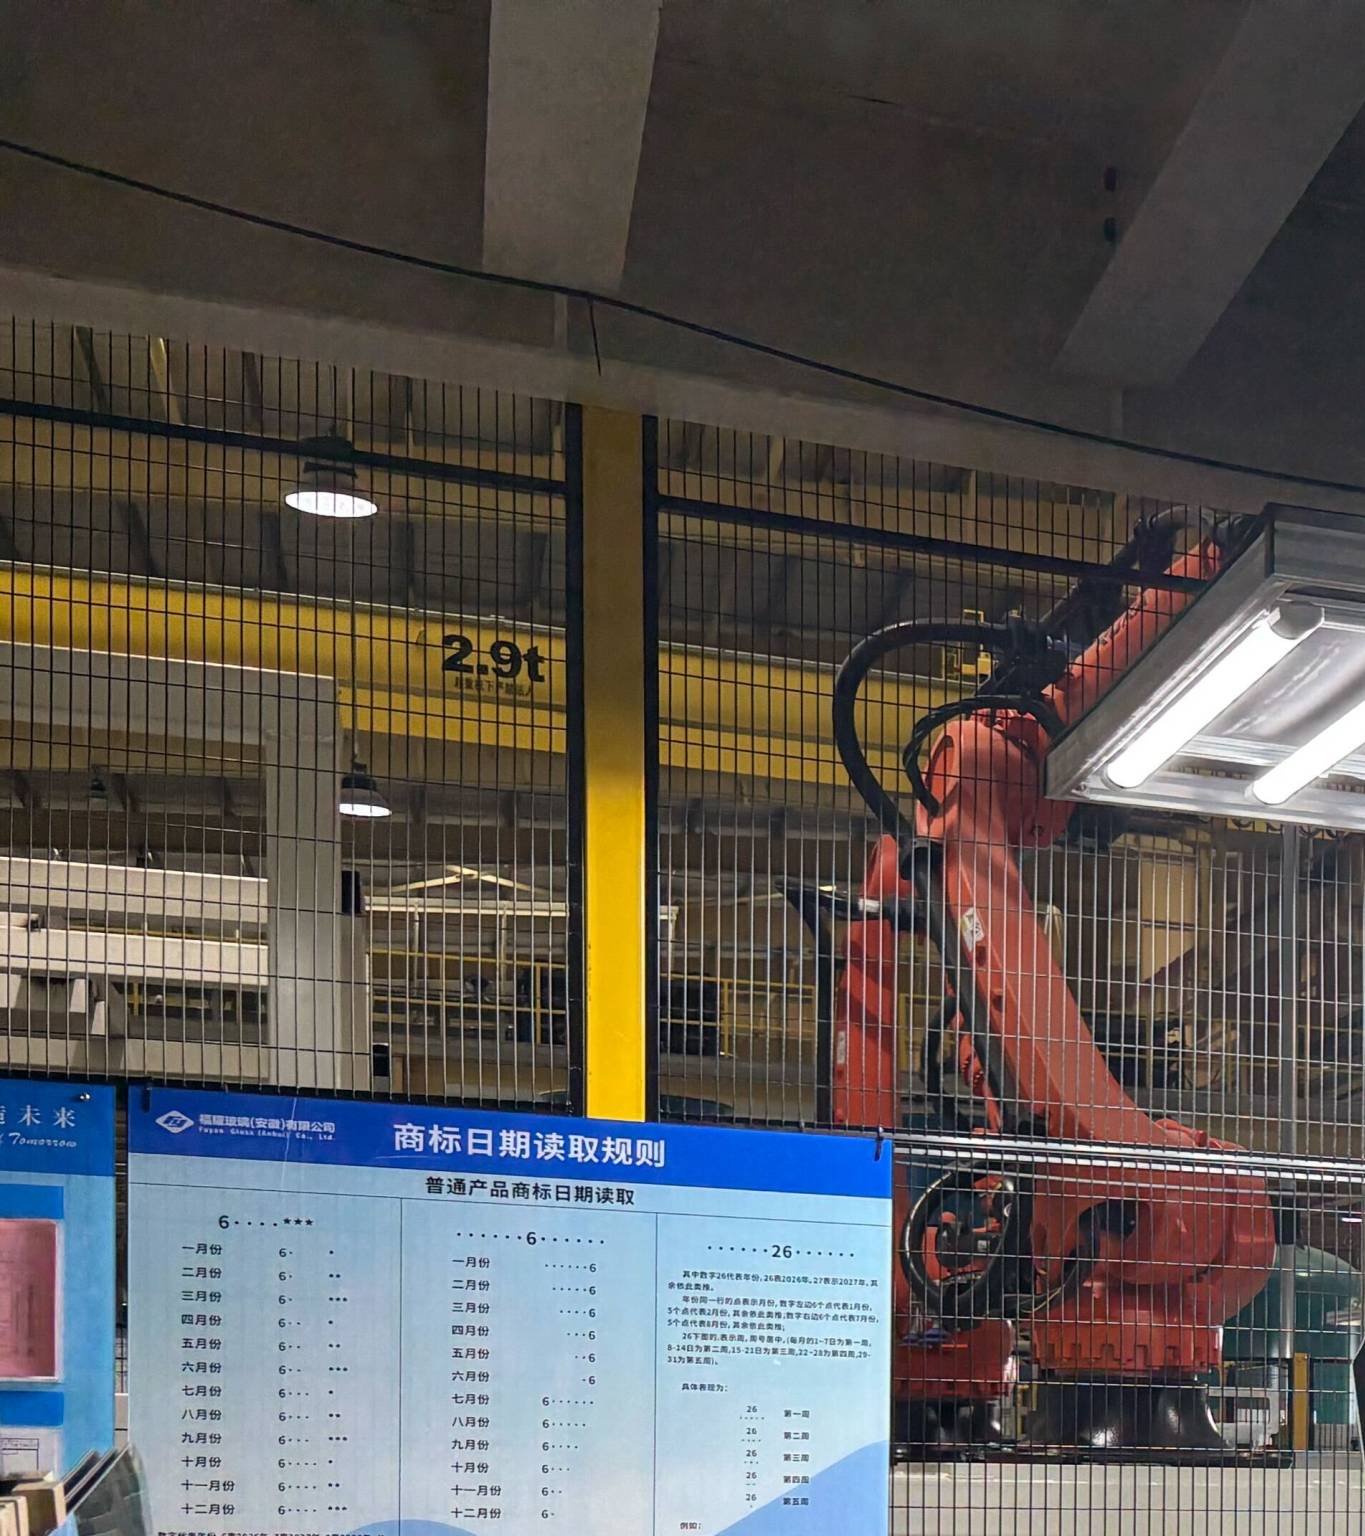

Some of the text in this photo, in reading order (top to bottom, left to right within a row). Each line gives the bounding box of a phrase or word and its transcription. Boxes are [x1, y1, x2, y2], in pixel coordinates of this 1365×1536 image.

[442, 634, 545, 682] 2.9t
[8, 1132, 77, 1147] Tomorrow
[393, 1122, 665, 1168] 商标日期读取规则
[425, 1176, 635, 1205] 普通产品商标日期读取
[181, 1243, 223, 1256] 一月份
[451, 1257, 490, 1268] 一月份
[181, 1266, 223, 1279] 二月份
[451, 1280, 490, 1291] 二月份
[181, 1291, 223, 1303] 三月份
[451, 1302, 490, 1314] 三月份
[181, 1314, 223, 1326] 四月份
[451, 1326, 490, 1337] 四月份
[181, 1338, 223, 1350] 五月份
[451, 1348, 490, 1360] 五月份
[181, 1362, 223, 1374] 六月份
[451, 1371, 490, 1382] 六月份
[181, 1385, 223, 1397] 七月份
[451, 1394, 490, 1405] 七月份
[181, 1409, 223, 1421] 八月份
[451, 1416, 490, 1428] 八月份
[181, 1432, 223, 1444] 九月份
[451, 1439, 490, 1451] 九月份
[181, 1456, 223, 1468] 十月份
[451, 1462, 490, 1474] 十月份
[181, 1480, 236, 1492] 十一月份
[451, 1485, 501, 1496] 十一月份
[181, 1503, 236, 1516] 十二月份
[451, 1507, 501, 1519] 十二月份
